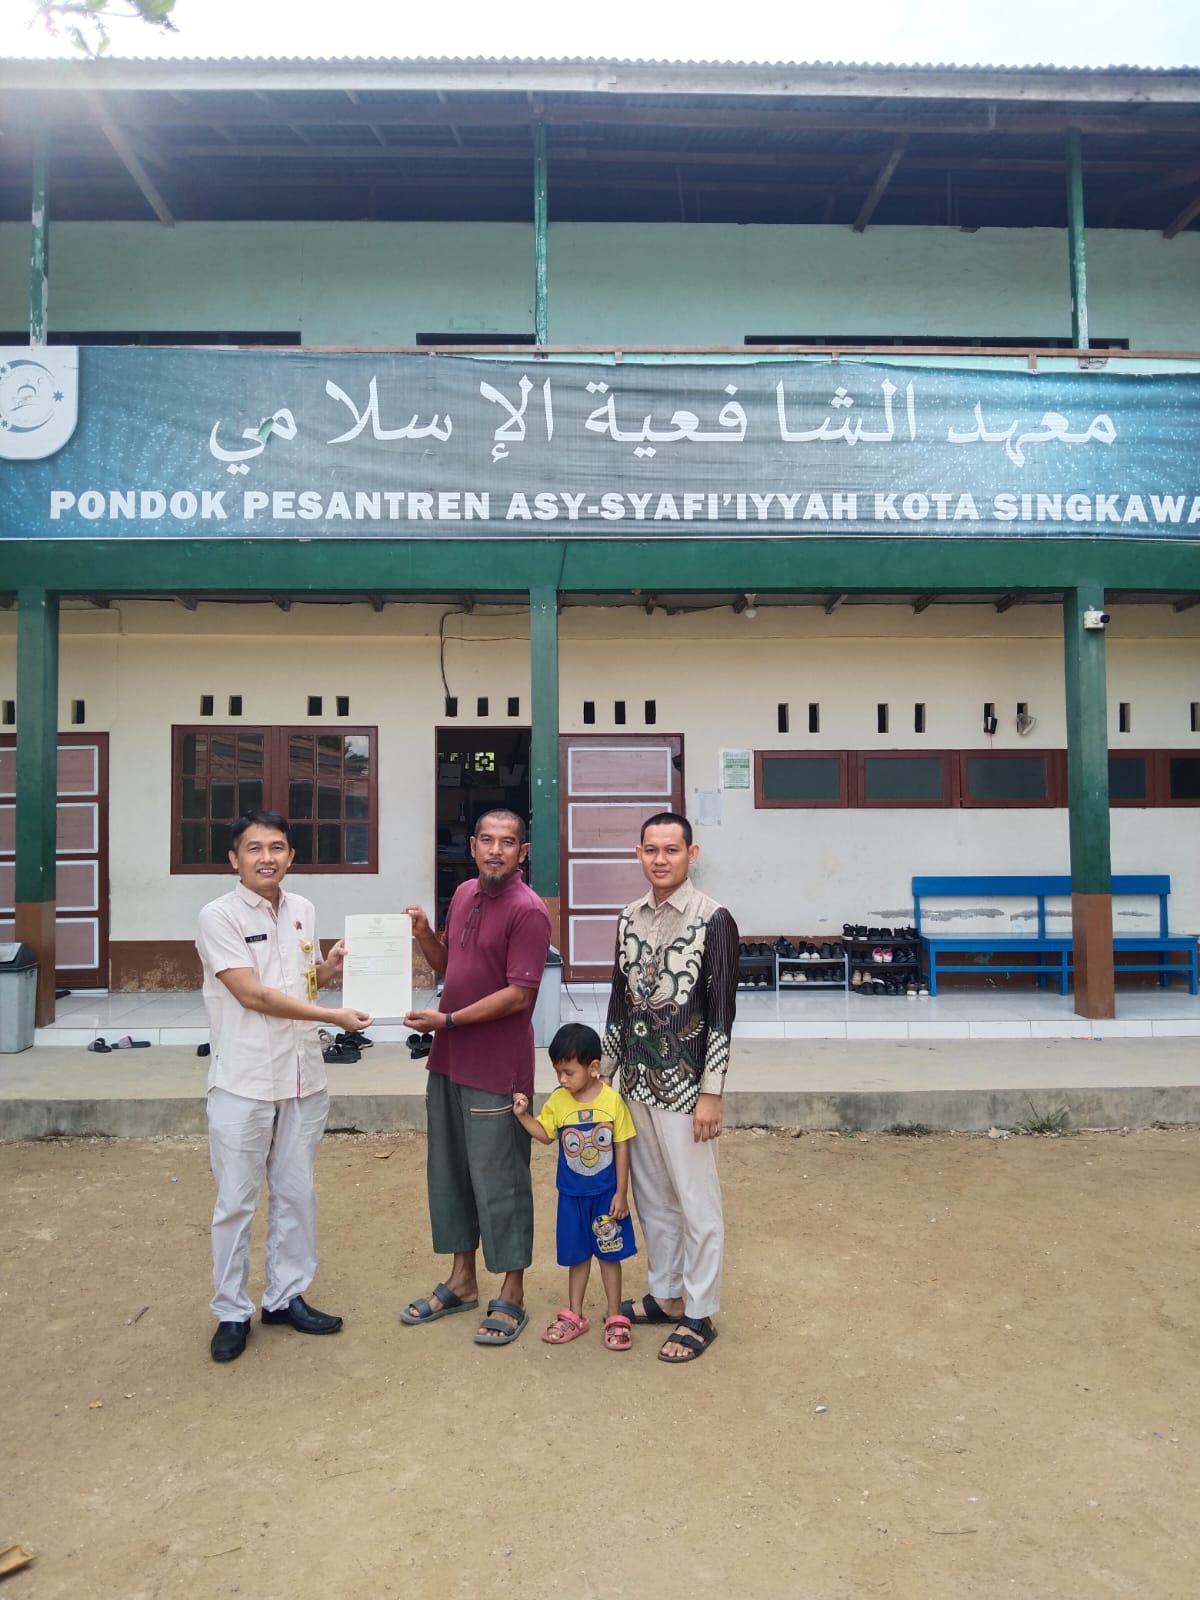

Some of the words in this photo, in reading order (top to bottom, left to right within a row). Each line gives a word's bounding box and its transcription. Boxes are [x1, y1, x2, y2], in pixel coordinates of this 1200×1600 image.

[946, 399, 1118, 469] معهد
[50, 490, 227, 519] PONDOK
[243, 491, 490, 520] PESANTREN
[874, 492, 981, 521] KOTA
